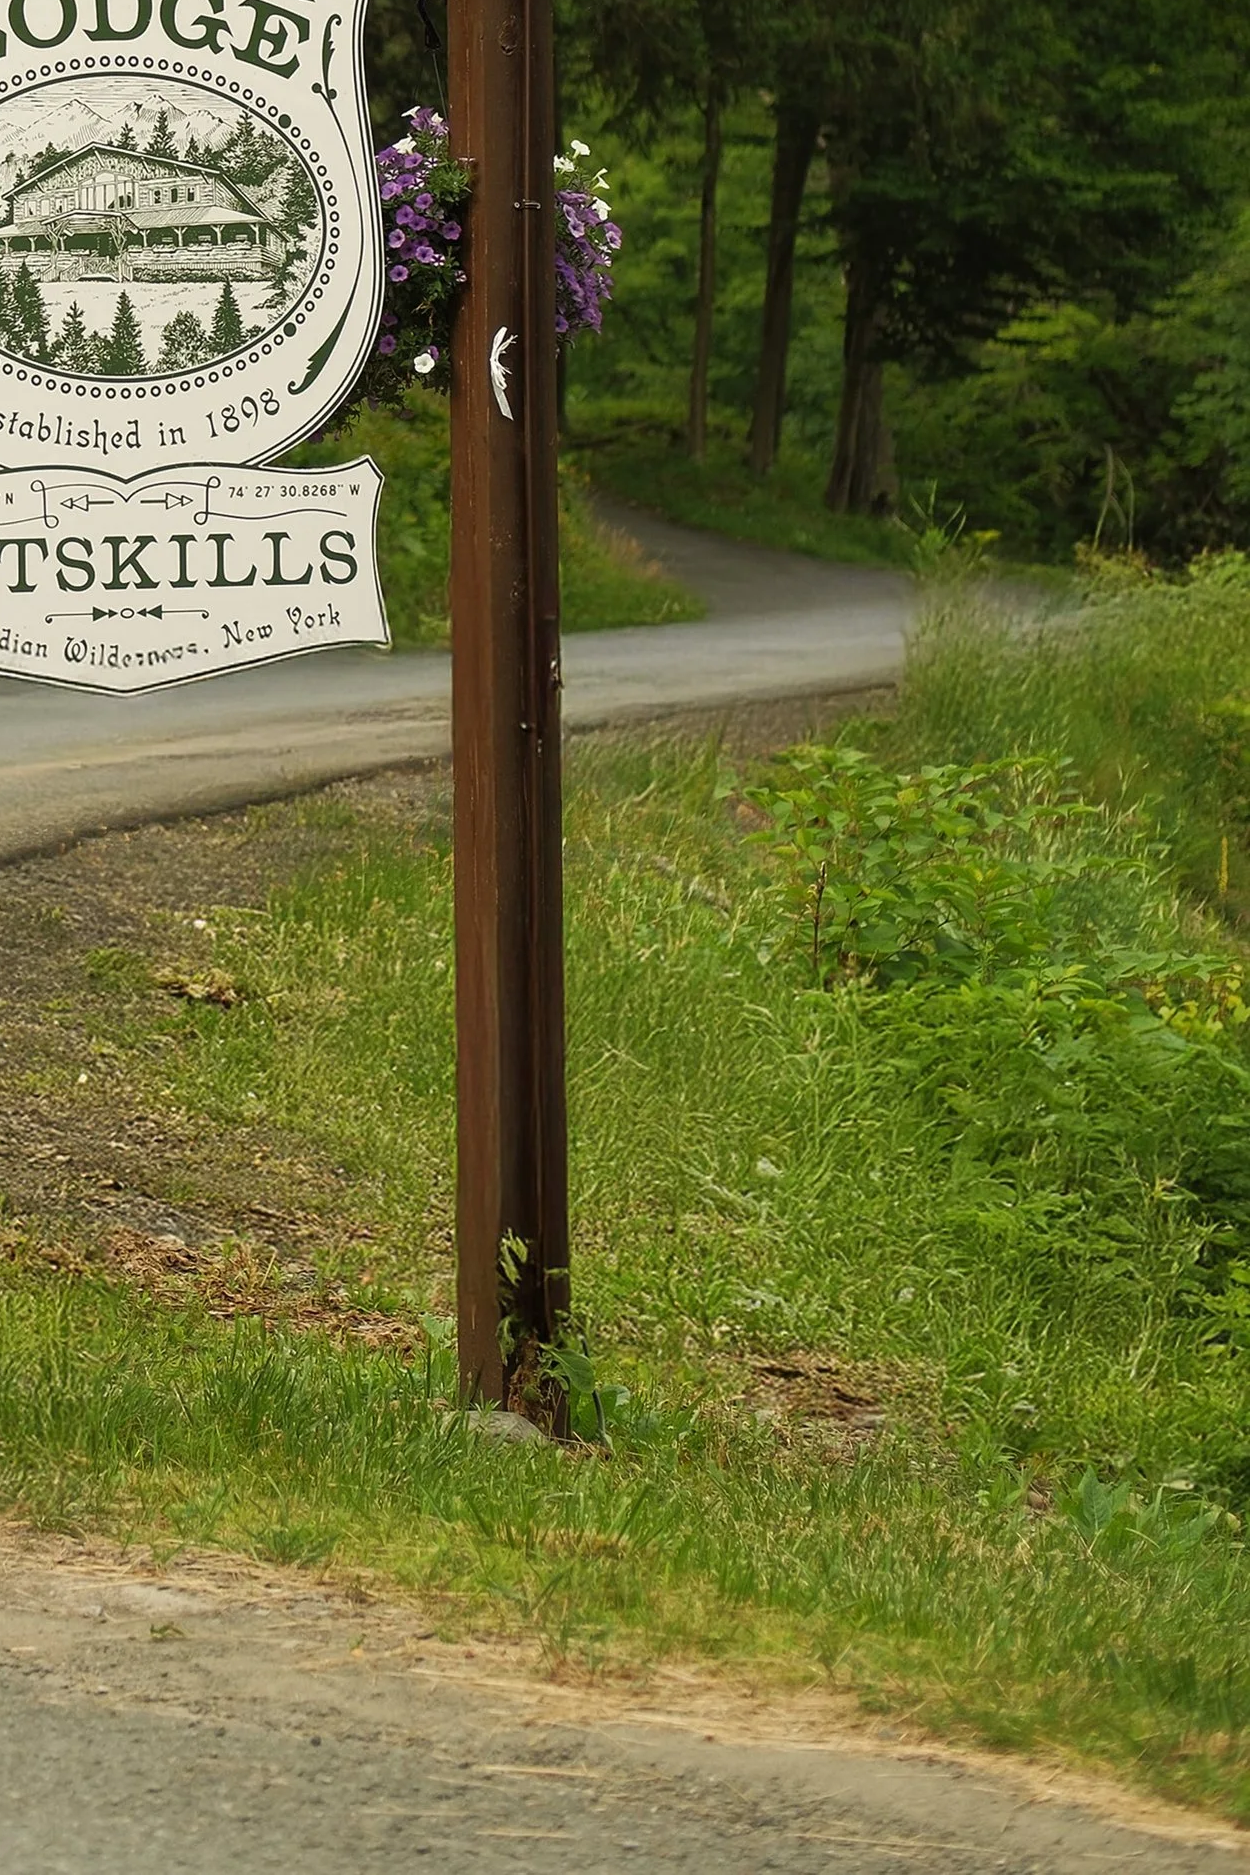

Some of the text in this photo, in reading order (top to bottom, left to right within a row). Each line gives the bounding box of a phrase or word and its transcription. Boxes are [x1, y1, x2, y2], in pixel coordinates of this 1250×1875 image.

[158, 421, 187, 447] in
[206, 388, 281, 438] 1898
[5, 492, 14, 505] N
[349, 483, 361, 496] W
[220, 620, 274, 649] New
[285, 602, 341, 635] York
